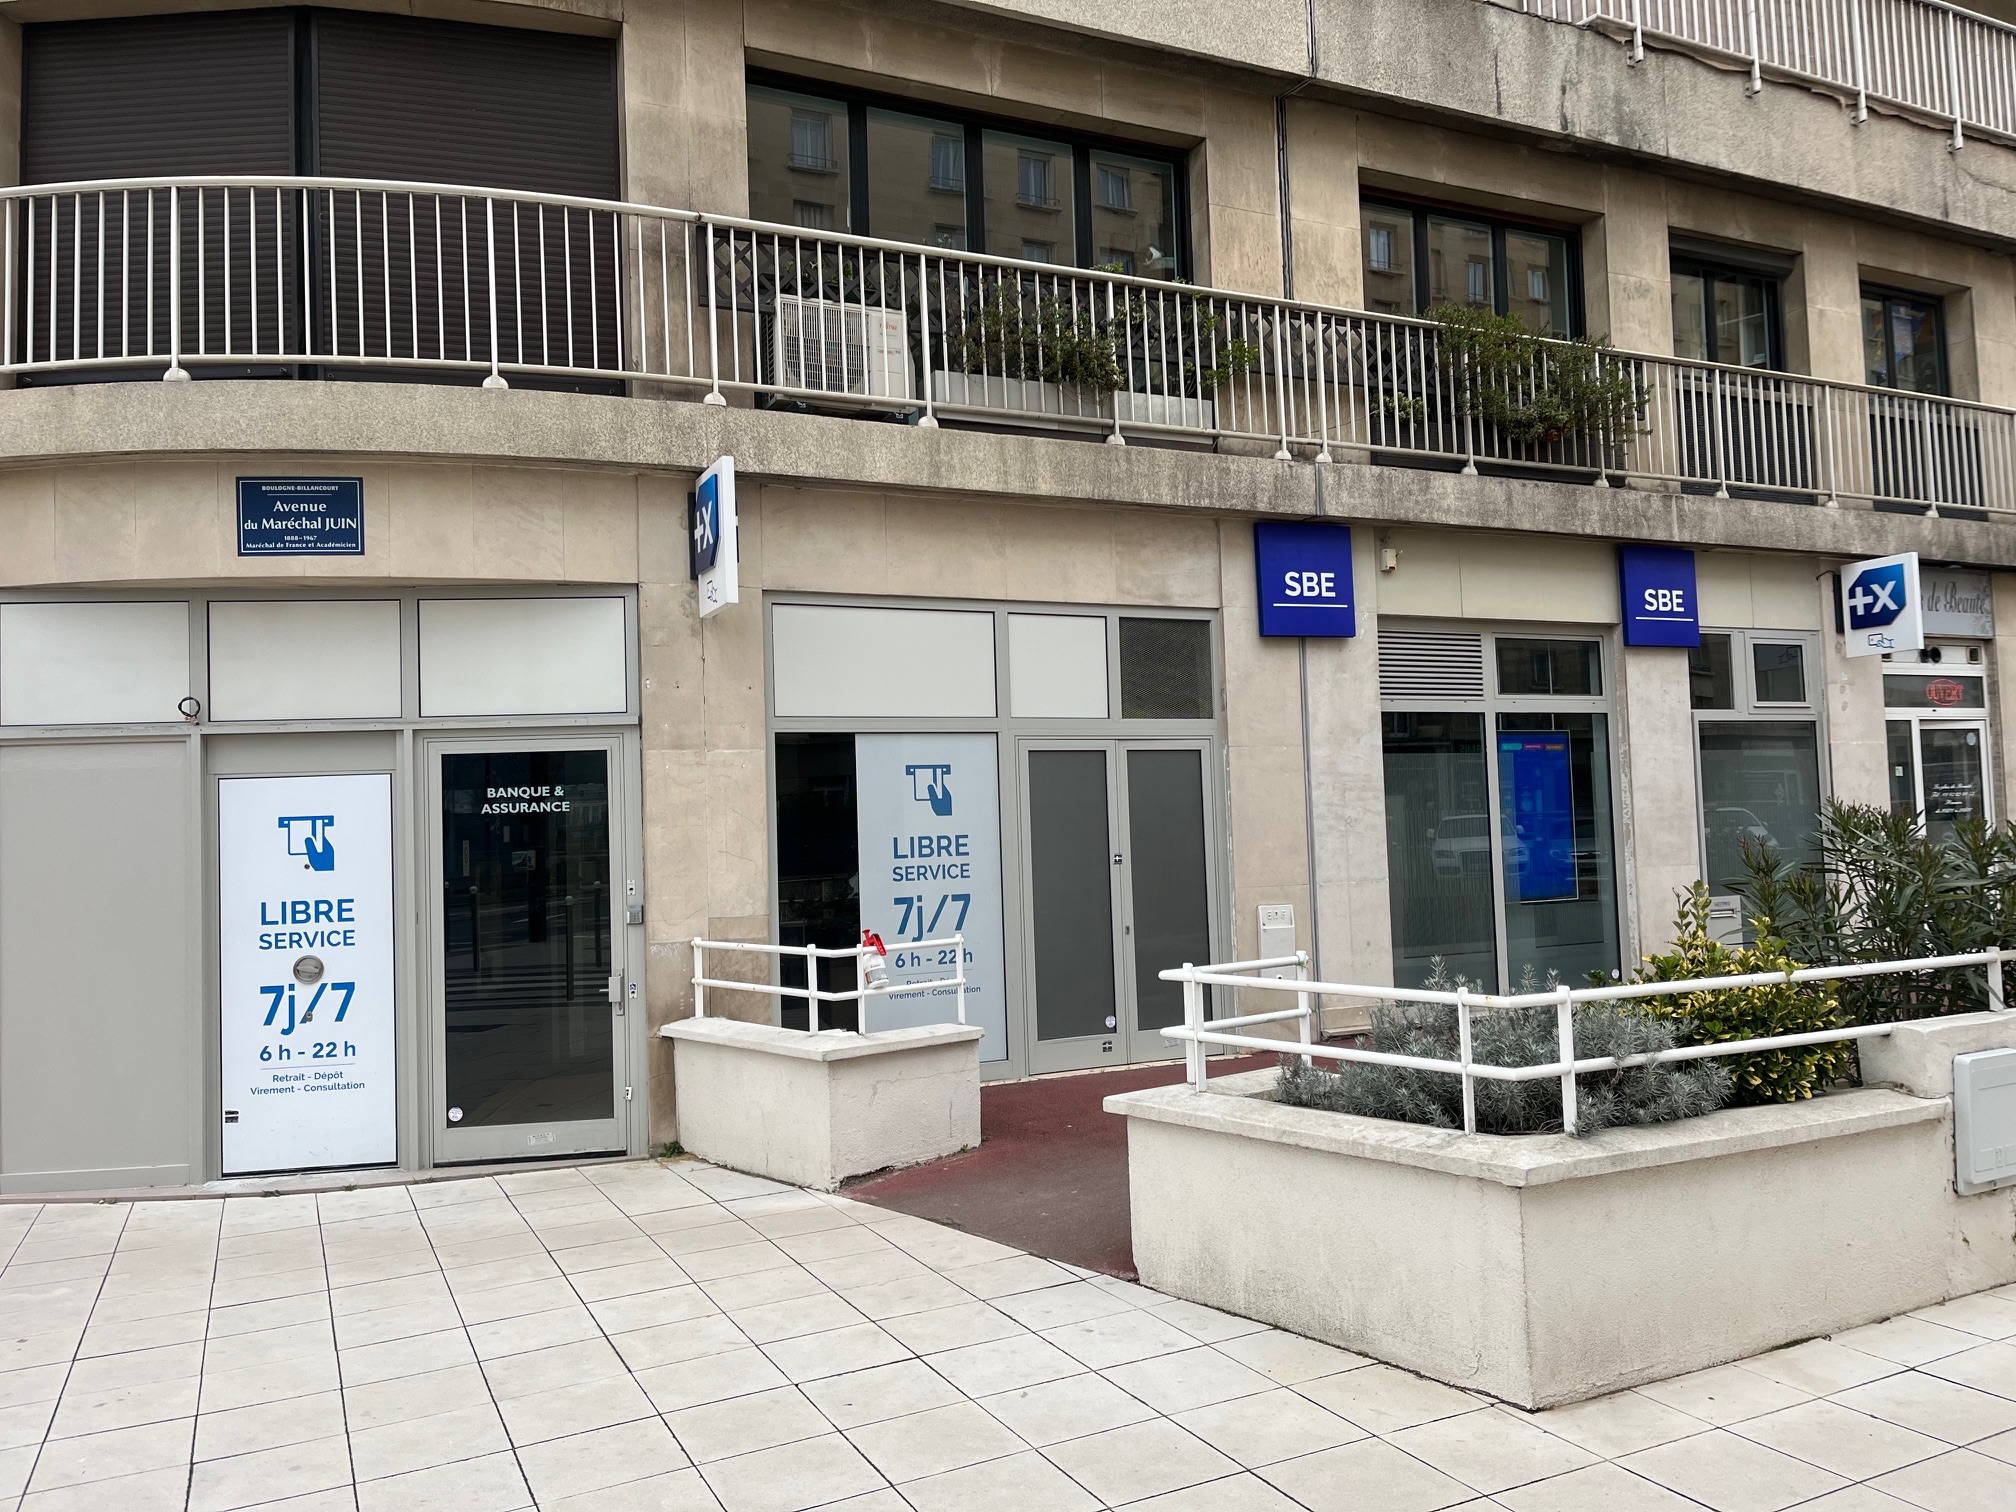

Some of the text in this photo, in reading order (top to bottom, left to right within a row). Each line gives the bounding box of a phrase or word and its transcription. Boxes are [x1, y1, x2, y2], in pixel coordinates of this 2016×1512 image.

[273, 500, 327, 512] Avenue
[244, 516, 357, 531] du Maréchal JUIN
[1284, 571, 1336, 597] SBE
[1644, 588, 1685, 612] SBE
[1927, 581, 1941, 612] de
[487, 785, 565, 799] BANQUE &
[481, 801, 570, 814] ASSURANCE
[893, 834, 970, 860] LIBRE
[892, 863, 971, 883] SERVICE
[260, 898, 355, 926] LIBRE
[893, 893, 971, 942] 7j/7
[258, 929, 356, 951] SERVICE
[895, 953, 906, 969] 6
[910, 952, 921, 968] h
[888, 990, 926, 1000] Virement
[259, 981, 356, 1036] 7j/7
[259, 1045, 273, 1062] 6
[278, 1044, 291, 1061] h
[312, 1041, 338, 1059] 22
[344, 1040, 356, 1057] h
[272, 1073, 306, 1083] Retrait
[314, 1070, 344, 1081] Dépôt
[250, 1085, 295, 1096] Virement
[303, 1081, 366, 1093] Consultation
